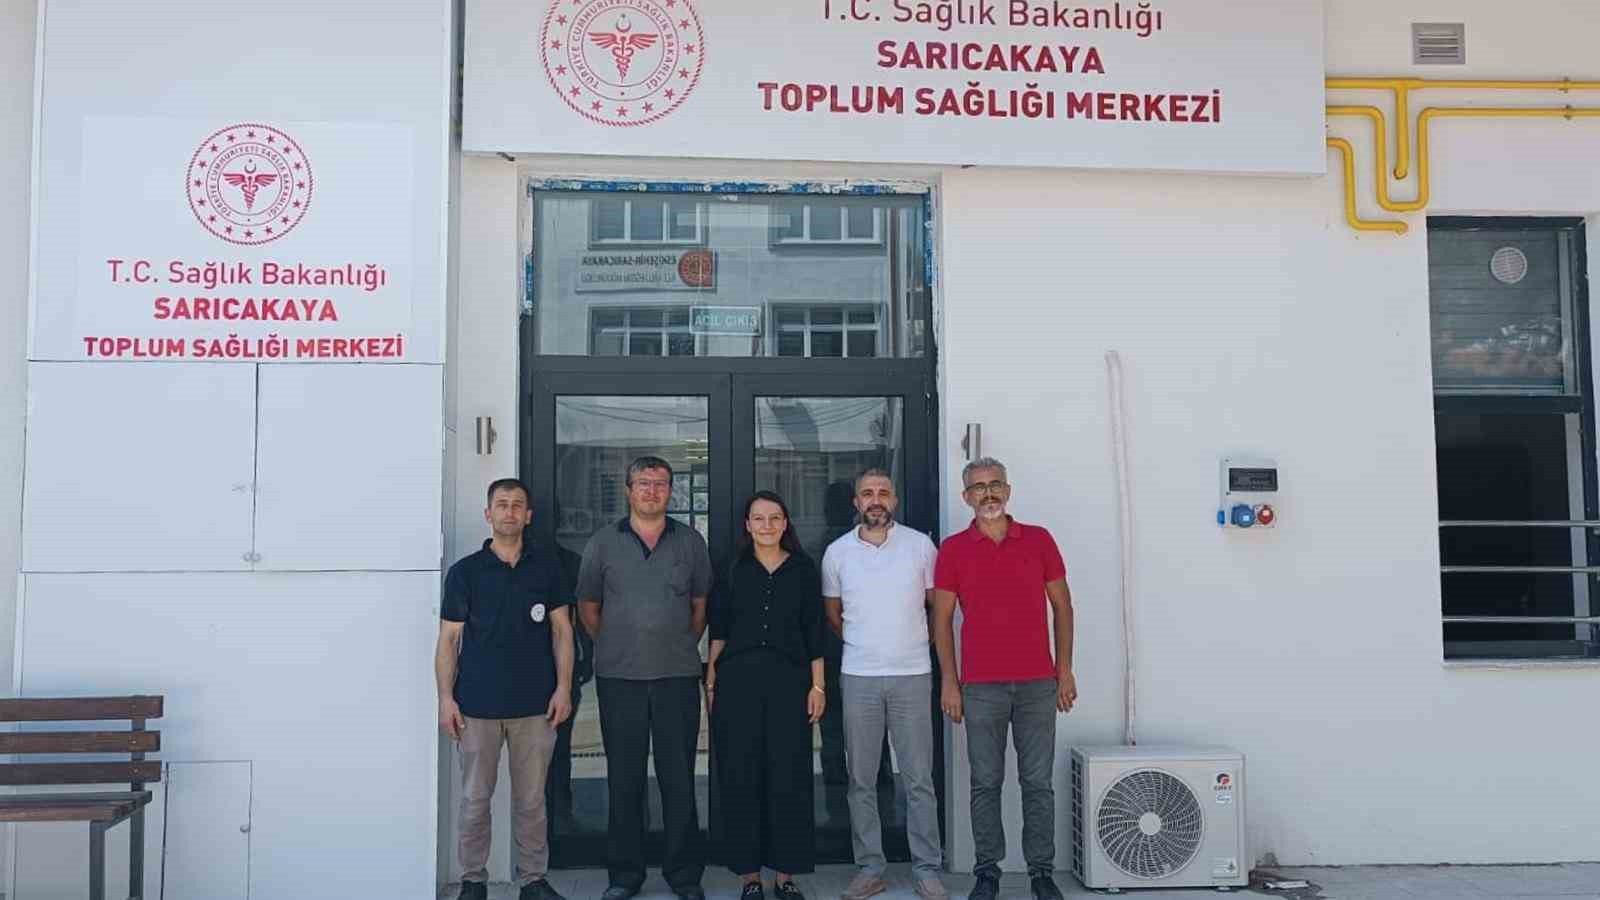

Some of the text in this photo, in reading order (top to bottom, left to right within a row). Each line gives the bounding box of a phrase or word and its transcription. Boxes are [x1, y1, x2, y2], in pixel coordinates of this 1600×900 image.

[894, 0, 995, 31] Sağlık
[1009, 0, 1162, 38] Bakanlığı
[877, 40, 1105, 75] SARICAKAYA
[758, 81, 1221, 123] TOPLUM SAĞLIĞI MERKEZİ
[107, 260, 386, 292] T.C. Sağlık Bakanlığı
[154, 297, 339, 322] SARICAKAYA
[84, 333, 403, 358] TOPLUM SAĞLIĞI MERKEZİ
